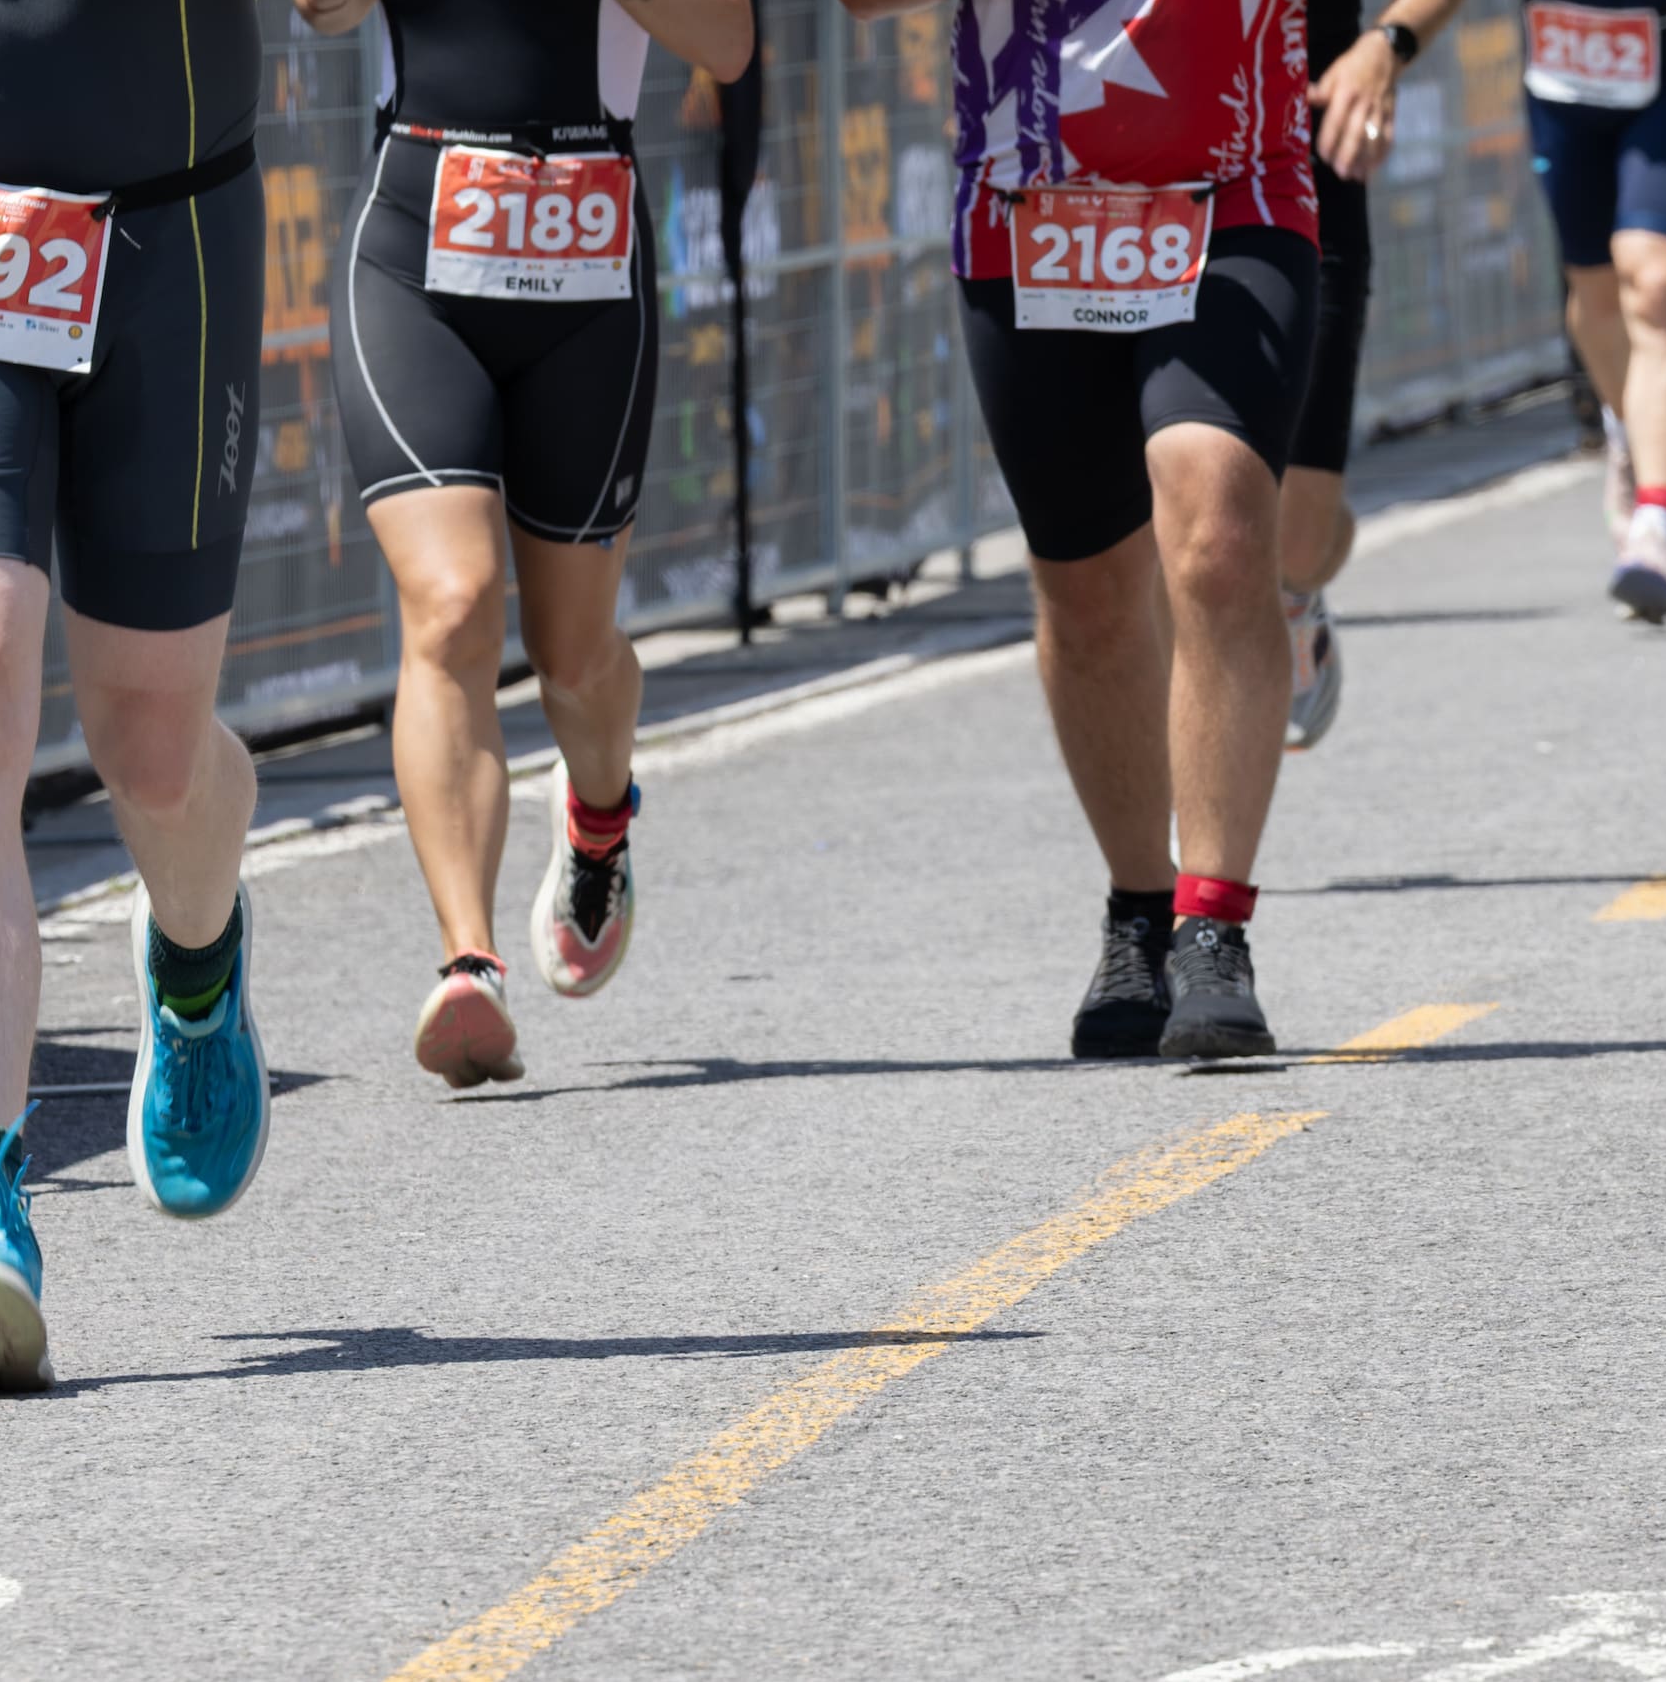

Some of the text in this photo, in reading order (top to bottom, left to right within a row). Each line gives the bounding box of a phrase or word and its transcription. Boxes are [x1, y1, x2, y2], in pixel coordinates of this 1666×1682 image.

[448, 187, 617, 252] 2189
[1030, 223, 1191, 284] 2168
[505, 276, 564, 293] EMILY
[1073, 308, 1149, 325] CONNOR
